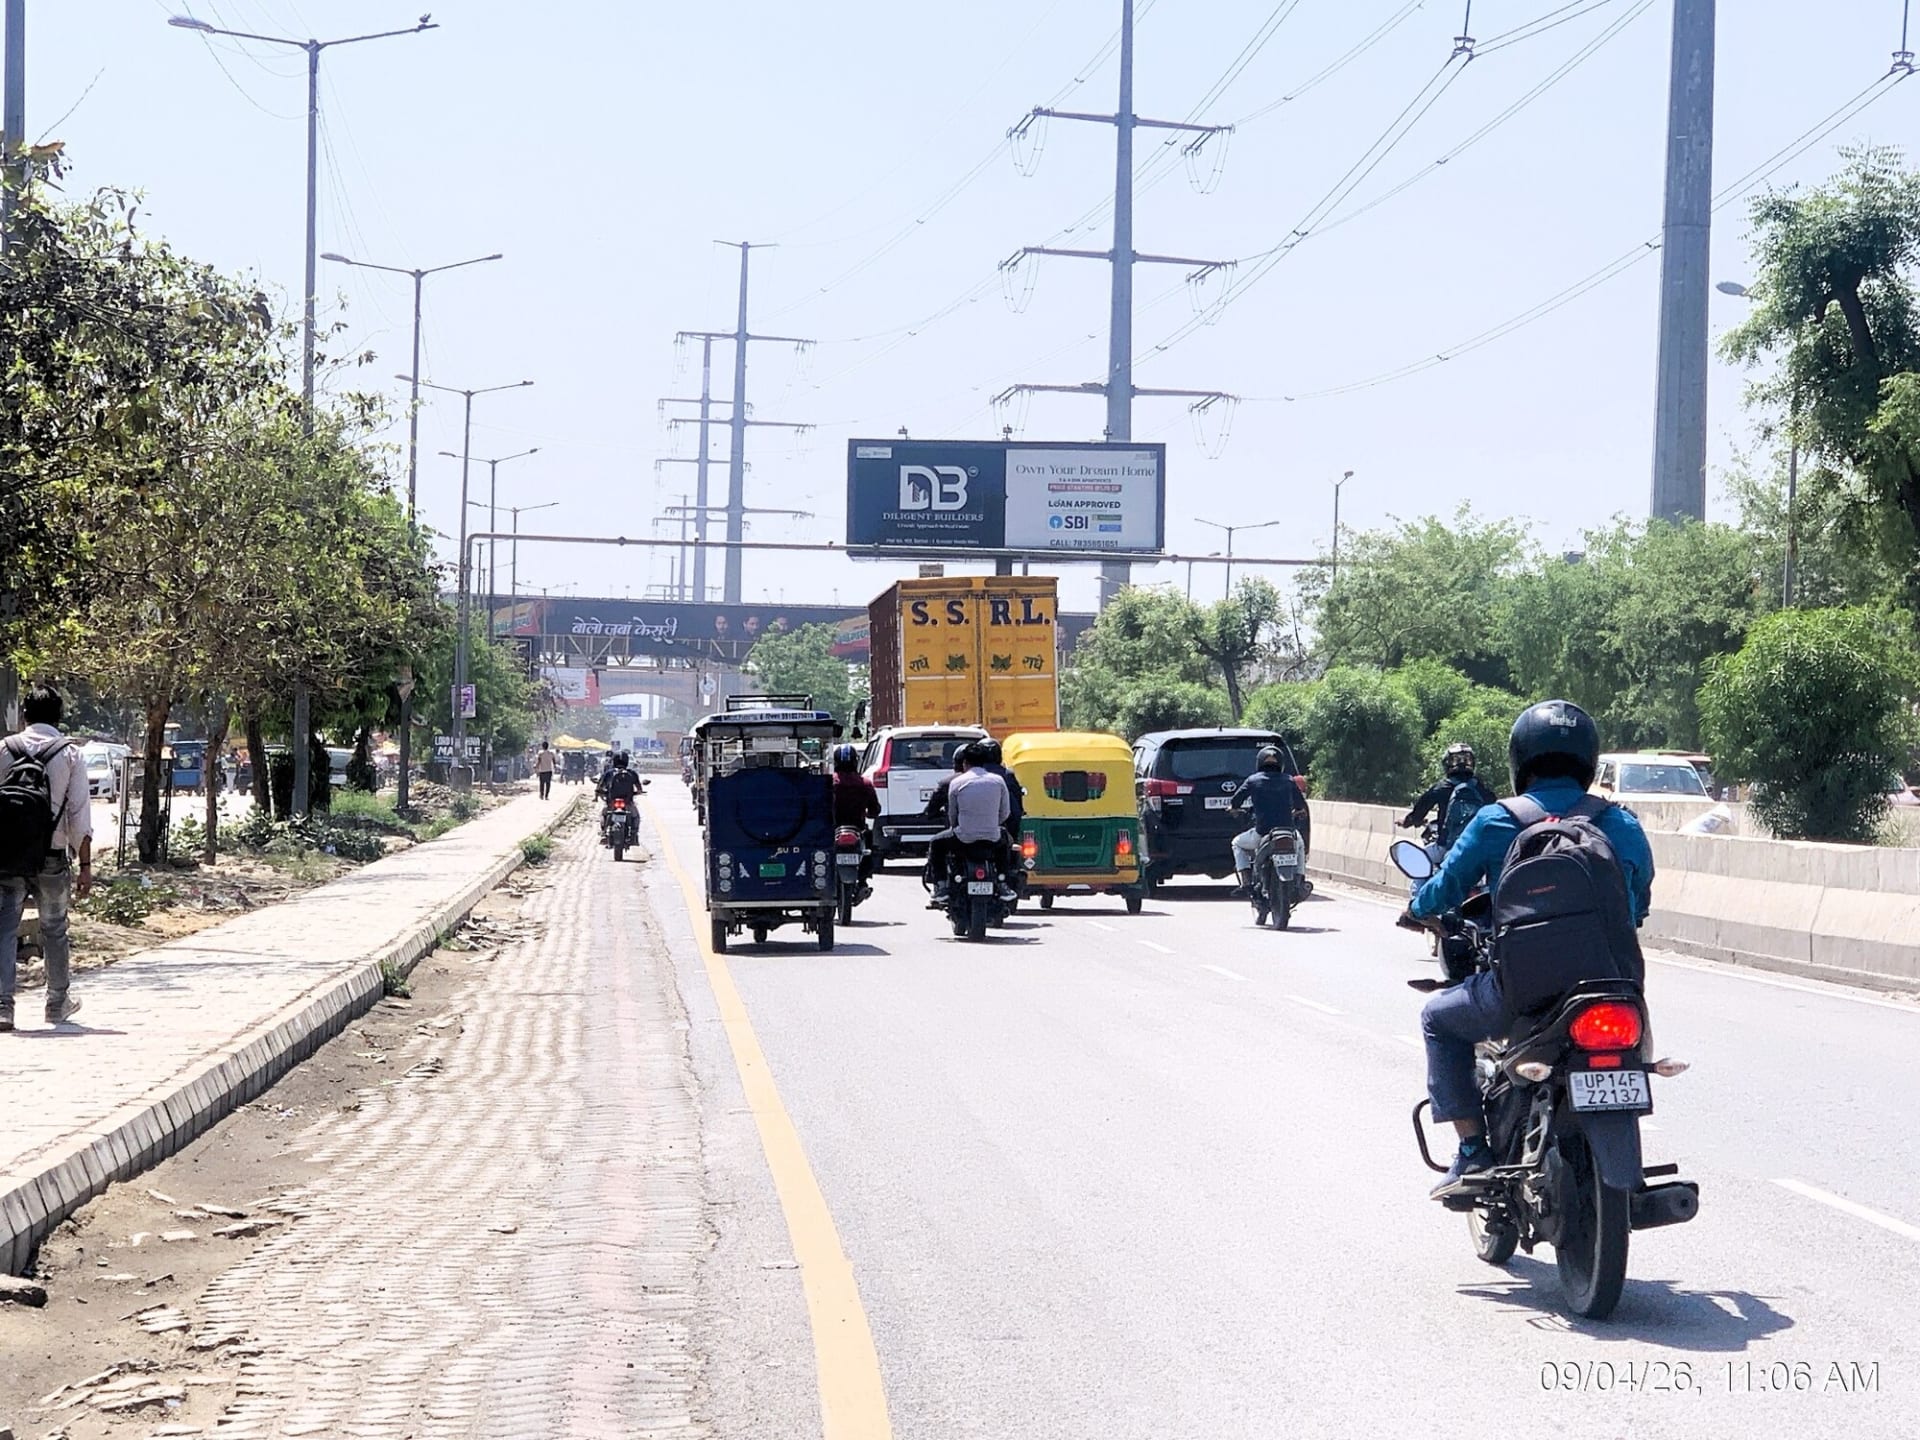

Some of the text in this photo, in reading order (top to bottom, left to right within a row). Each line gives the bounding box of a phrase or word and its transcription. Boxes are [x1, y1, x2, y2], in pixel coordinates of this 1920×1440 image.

[1015, 464, 1155, 477] Own Your Dream Home
[900, 465, 968, 511] DB
[1048, 500, 1121, 509] LOAN APPROVED
[882, 512, 984, 521] DILIGENT BUILDERS
[1064, 515, 1089, 530] SBI
[571, 616, 603, 635] बोलो
[633, 616, 678, 645] केसरी
[910, 654, 930, 672] राधे
[437, 746, 481, 757] MALE
[1584, 1072, 1637, 1089] UP14F
[1587, 1088, 1640, 1105] Z2137
